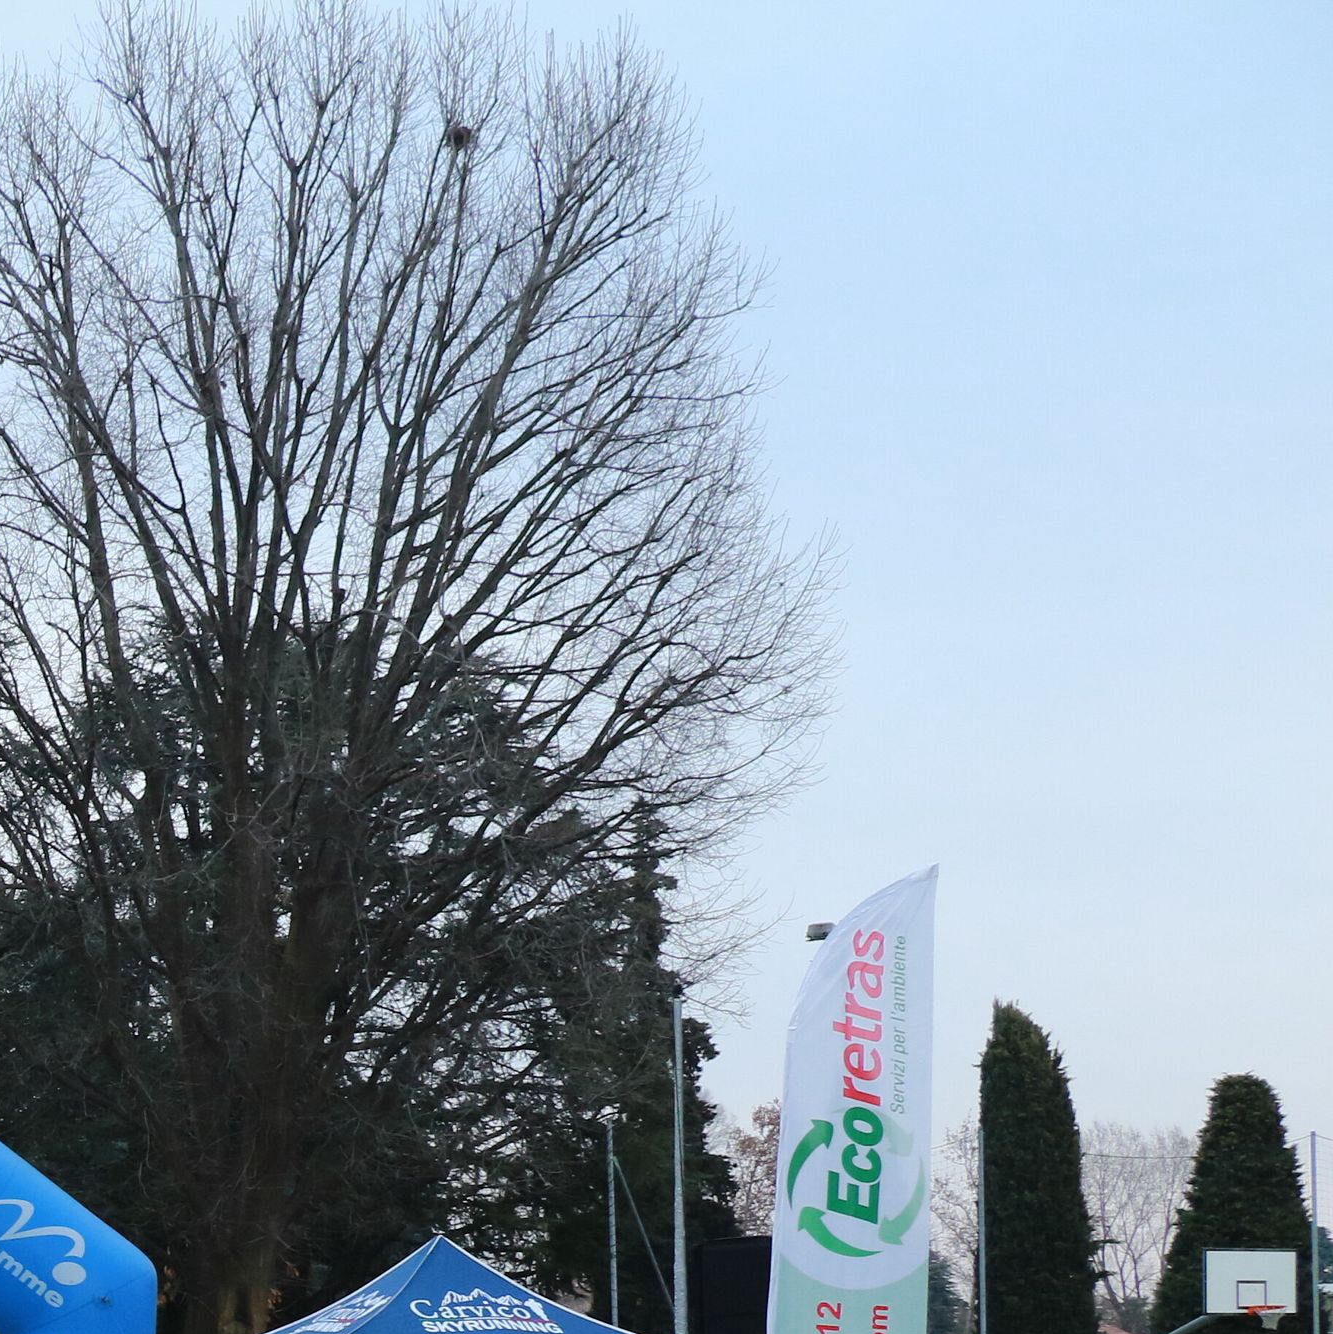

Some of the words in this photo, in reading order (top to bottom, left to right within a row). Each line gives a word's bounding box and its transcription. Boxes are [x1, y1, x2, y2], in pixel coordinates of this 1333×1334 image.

[891, 935, 906, 1021] l'ambiente
[893, 1028, 909, 1055] per
[826, 928, 886, 1225] Ecoretras
[890, 1059, 905, 1114] Servizi
[409, 1299, 532, 1320] Carvico
[421, 1319, 564, 1334] SKYRUNNING
